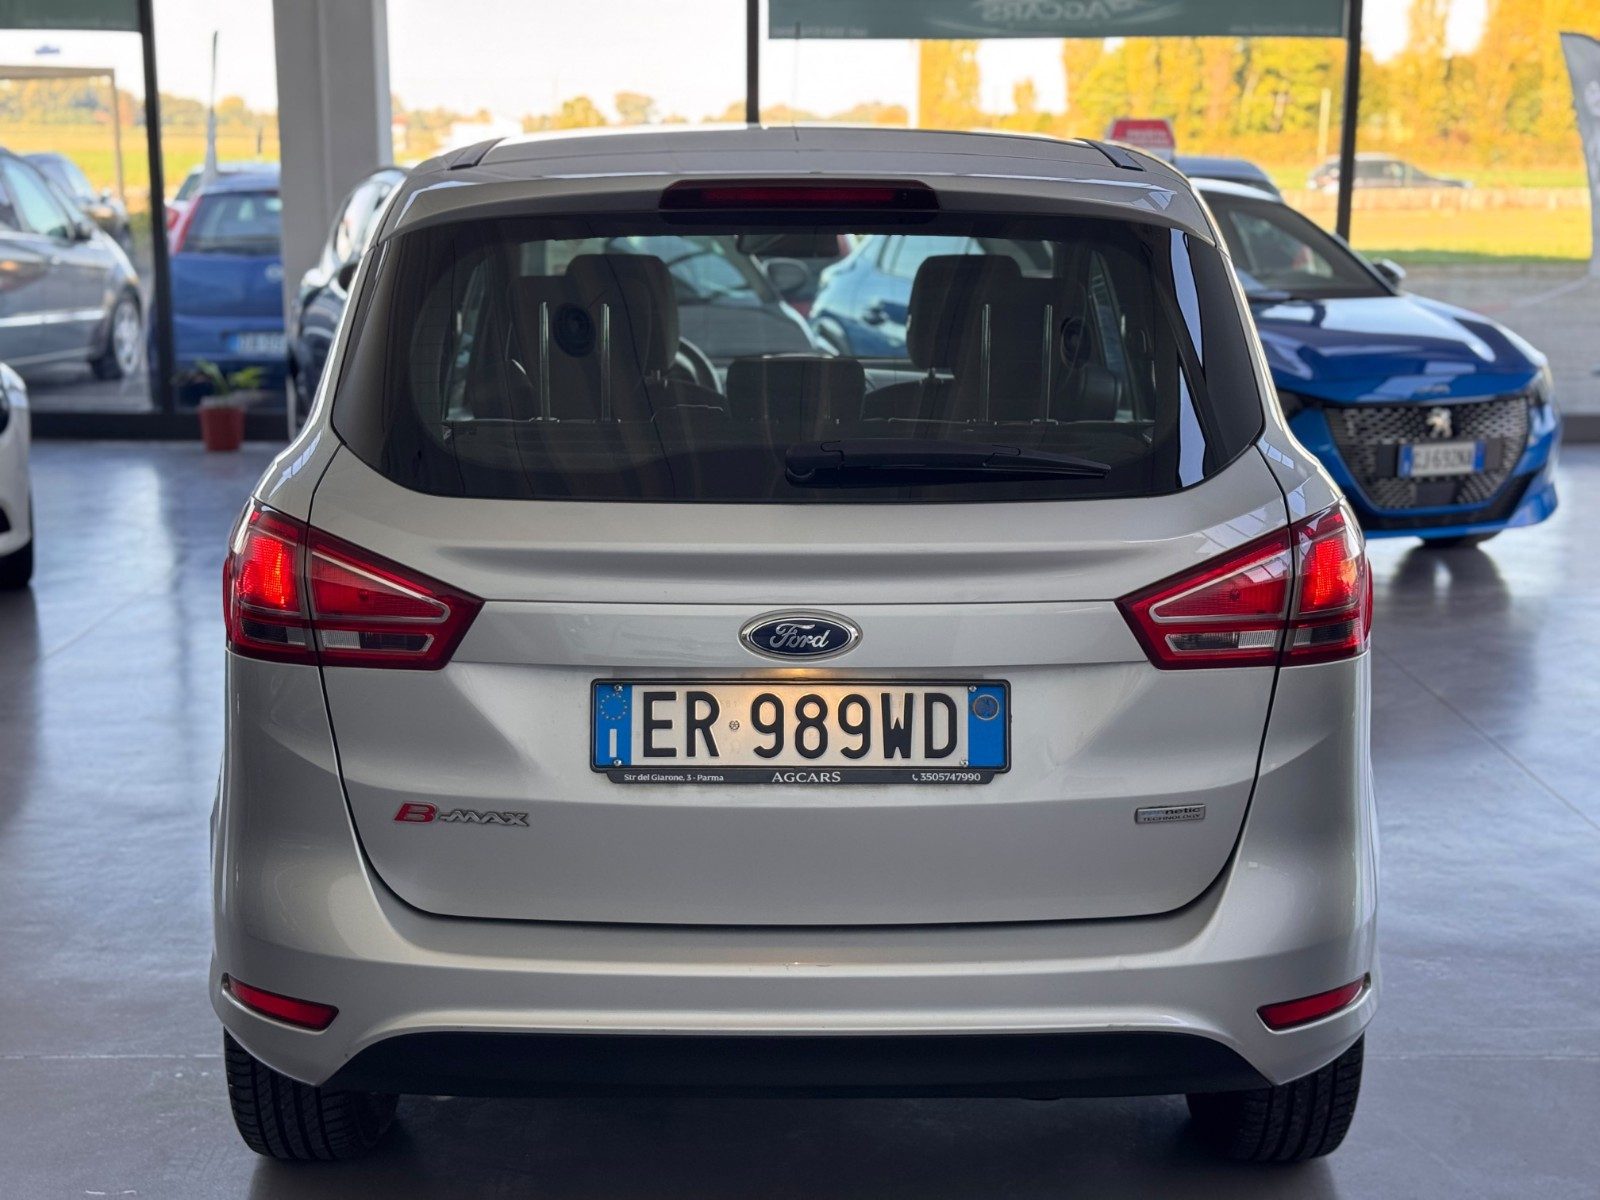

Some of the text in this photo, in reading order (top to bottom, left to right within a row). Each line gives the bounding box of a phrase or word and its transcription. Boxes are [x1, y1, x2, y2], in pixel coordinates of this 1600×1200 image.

[769, 623, 831, 648] Ford
[643, 691, 958, 759] ER 989WD
[624, 773, 637, 781] Str
[637, 773, 650, 781] del
[651, 773, 685, 782] Giarone,
[686, 773, 692, 781] 3
[771, 771, 842, 783] AGCARS
[920, 773, 981, 782] 3505747990
[394, 802, 530, 827] B-MAX
